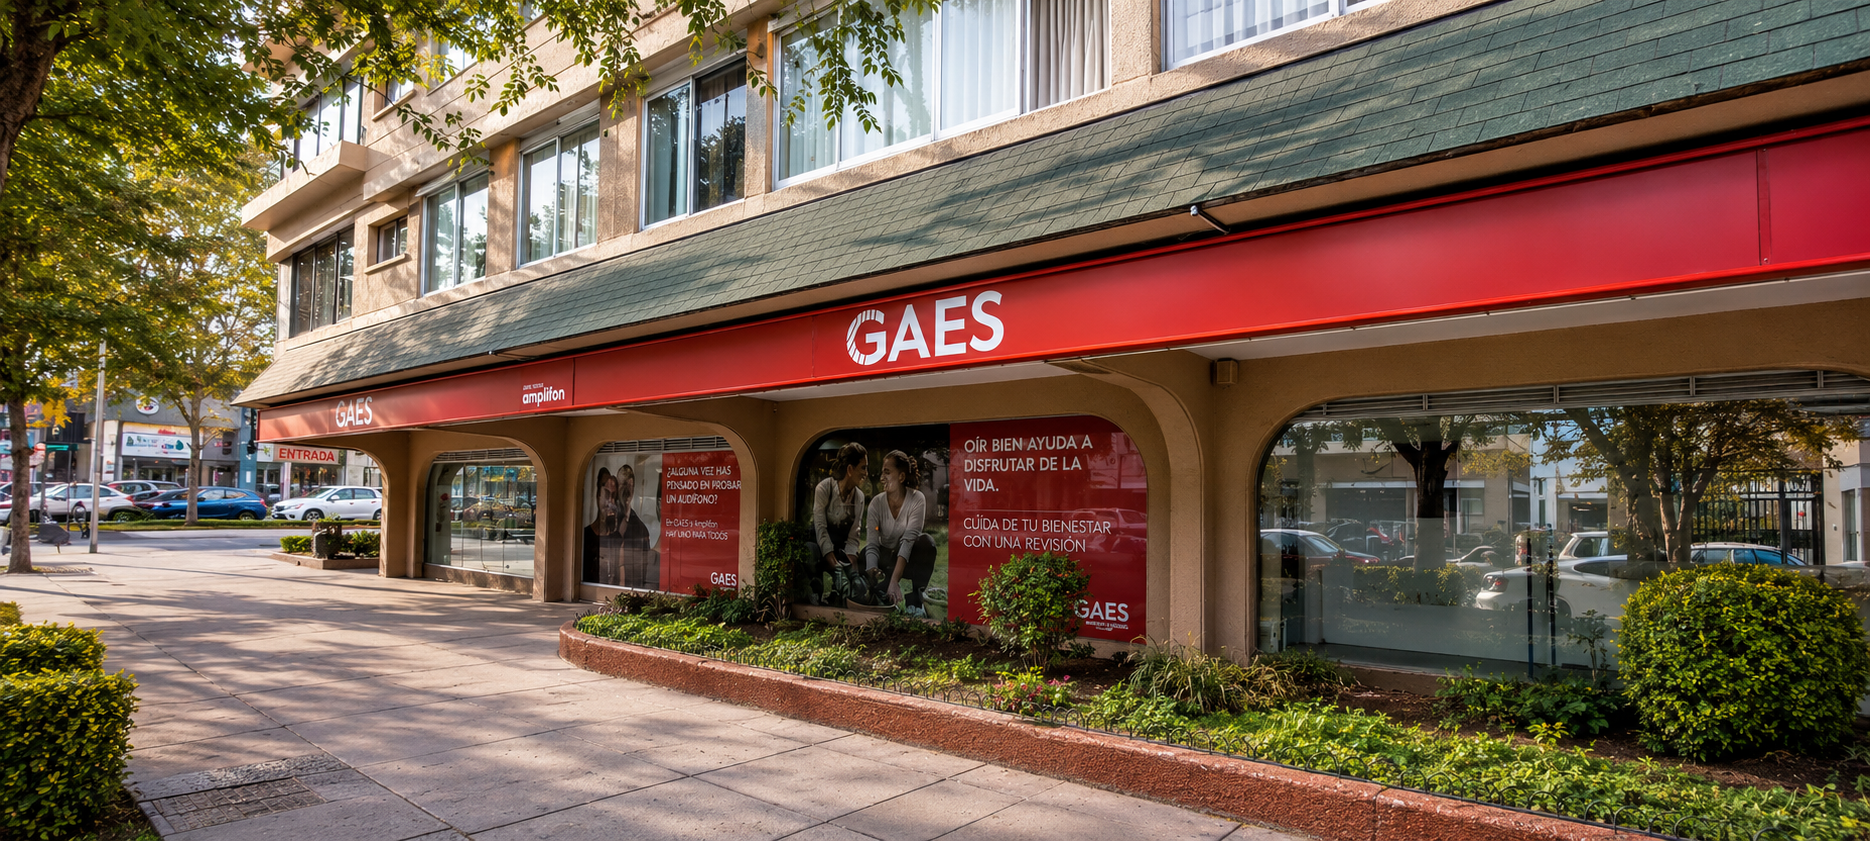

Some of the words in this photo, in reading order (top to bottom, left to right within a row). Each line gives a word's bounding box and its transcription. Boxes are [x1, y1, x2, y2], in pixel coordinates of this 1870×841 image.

[846, 290, 1005, 366] GAES
[522, 386, 565, 407] amplifon
[335, 396, 373, 428] GAES
[964, 436, 987, 453] OÍR
[992, 437, 1023, 452] BIEN
[1026, 435, 1078, 451] AYUDA
[1081, 435, 1093, 449] A
[279, 448, 335, 462] ENTRADA
[716, 465, 731, 476] HAS
[964, 457, 1035, 473] DISFRUTAR
[1039, 457, 1058, 471] DE
[1062, 456, 1082, 471] LA
[700, 480, 710, 490] EN
[964, 478, 999, 492] VIDA.
[666, 494, 677, 504] UN
[1002, 518, 1018, 531] DE
[1021, 519, 1038, 532] TU
[1042, 519, 1112, 535] BIENESTAR
[963, 535, 991, 548] CON
[994, 535, 1022, 549] UNA
[1025, 536, 1086, 552] REVISIÓN
[710, 571, 737, 587] GAES
[1074, 599, 1129, 622] GAES
